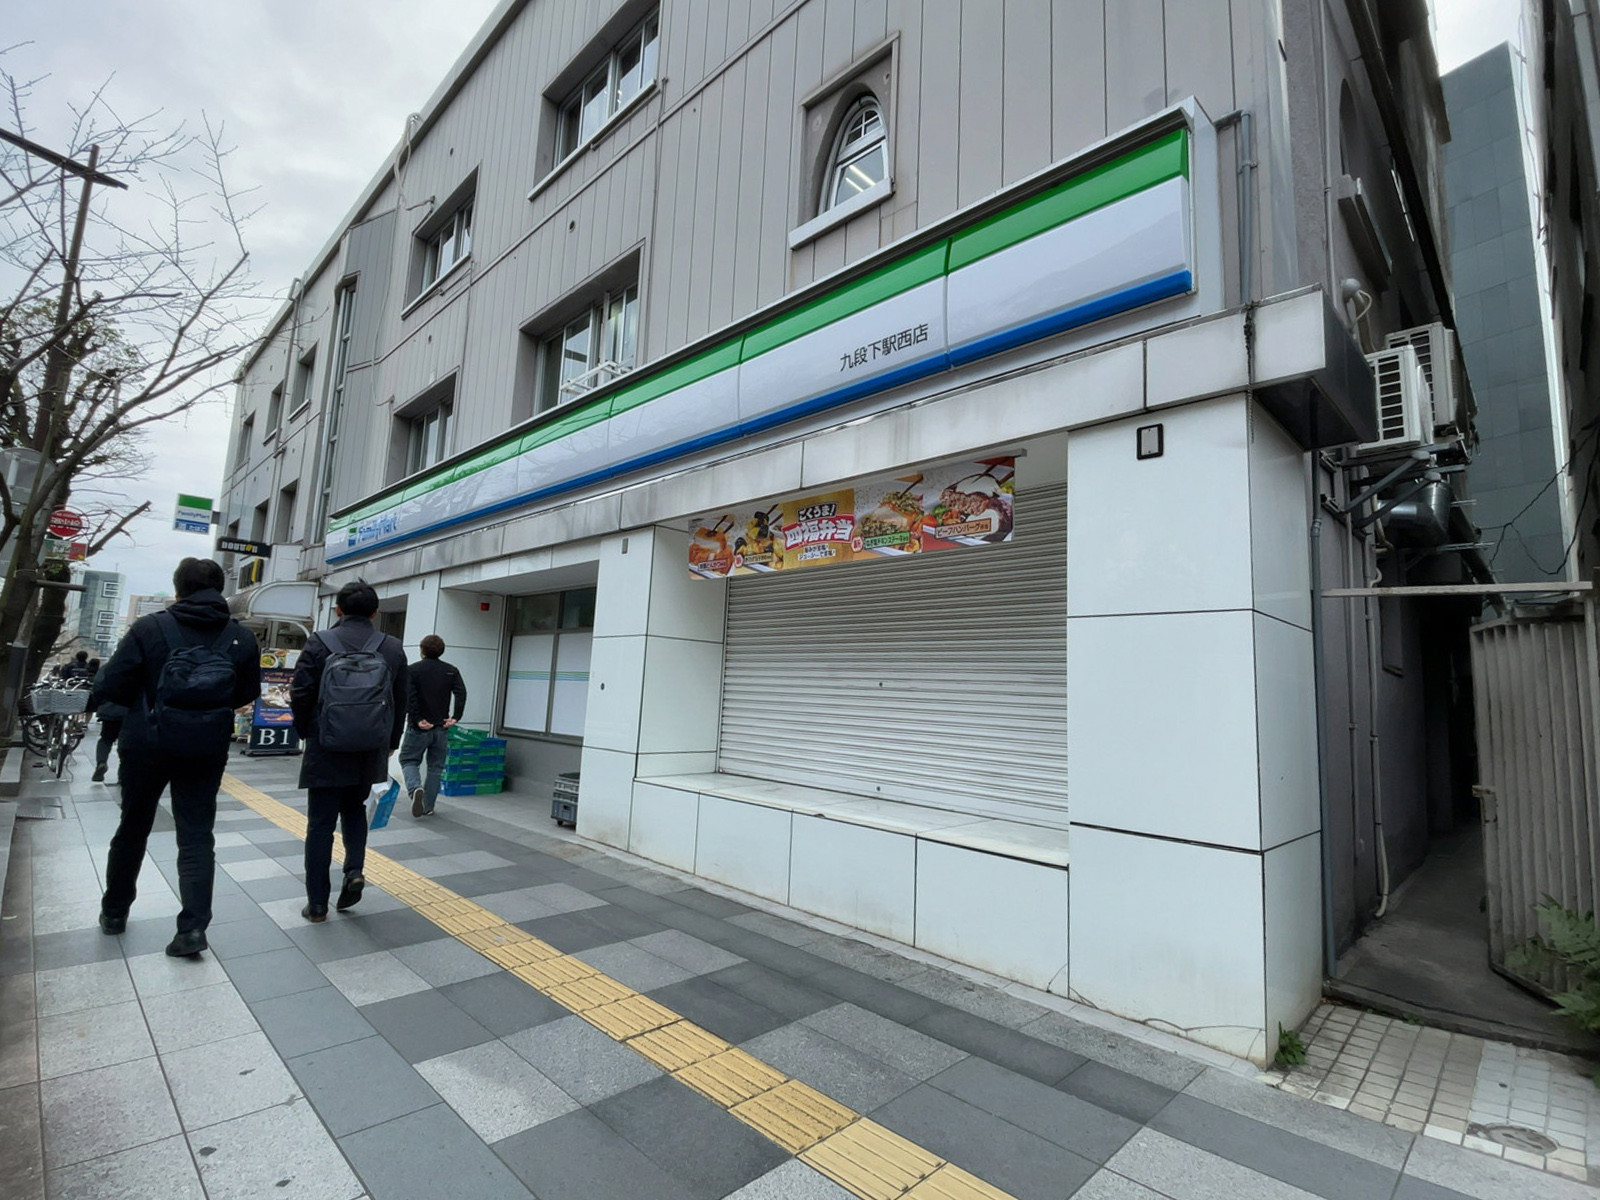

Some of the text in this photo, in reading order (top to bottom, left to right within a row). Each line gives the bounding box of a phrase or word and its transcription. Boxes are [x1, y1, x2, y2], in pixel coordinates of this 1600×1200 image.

[840, 323, 929, 372] 九段下駅西店
[177, 509, 211, 520] FamilyMart
[785, 517, 854, 548] 四福弁当
[257, 728, 290, 746] B1
